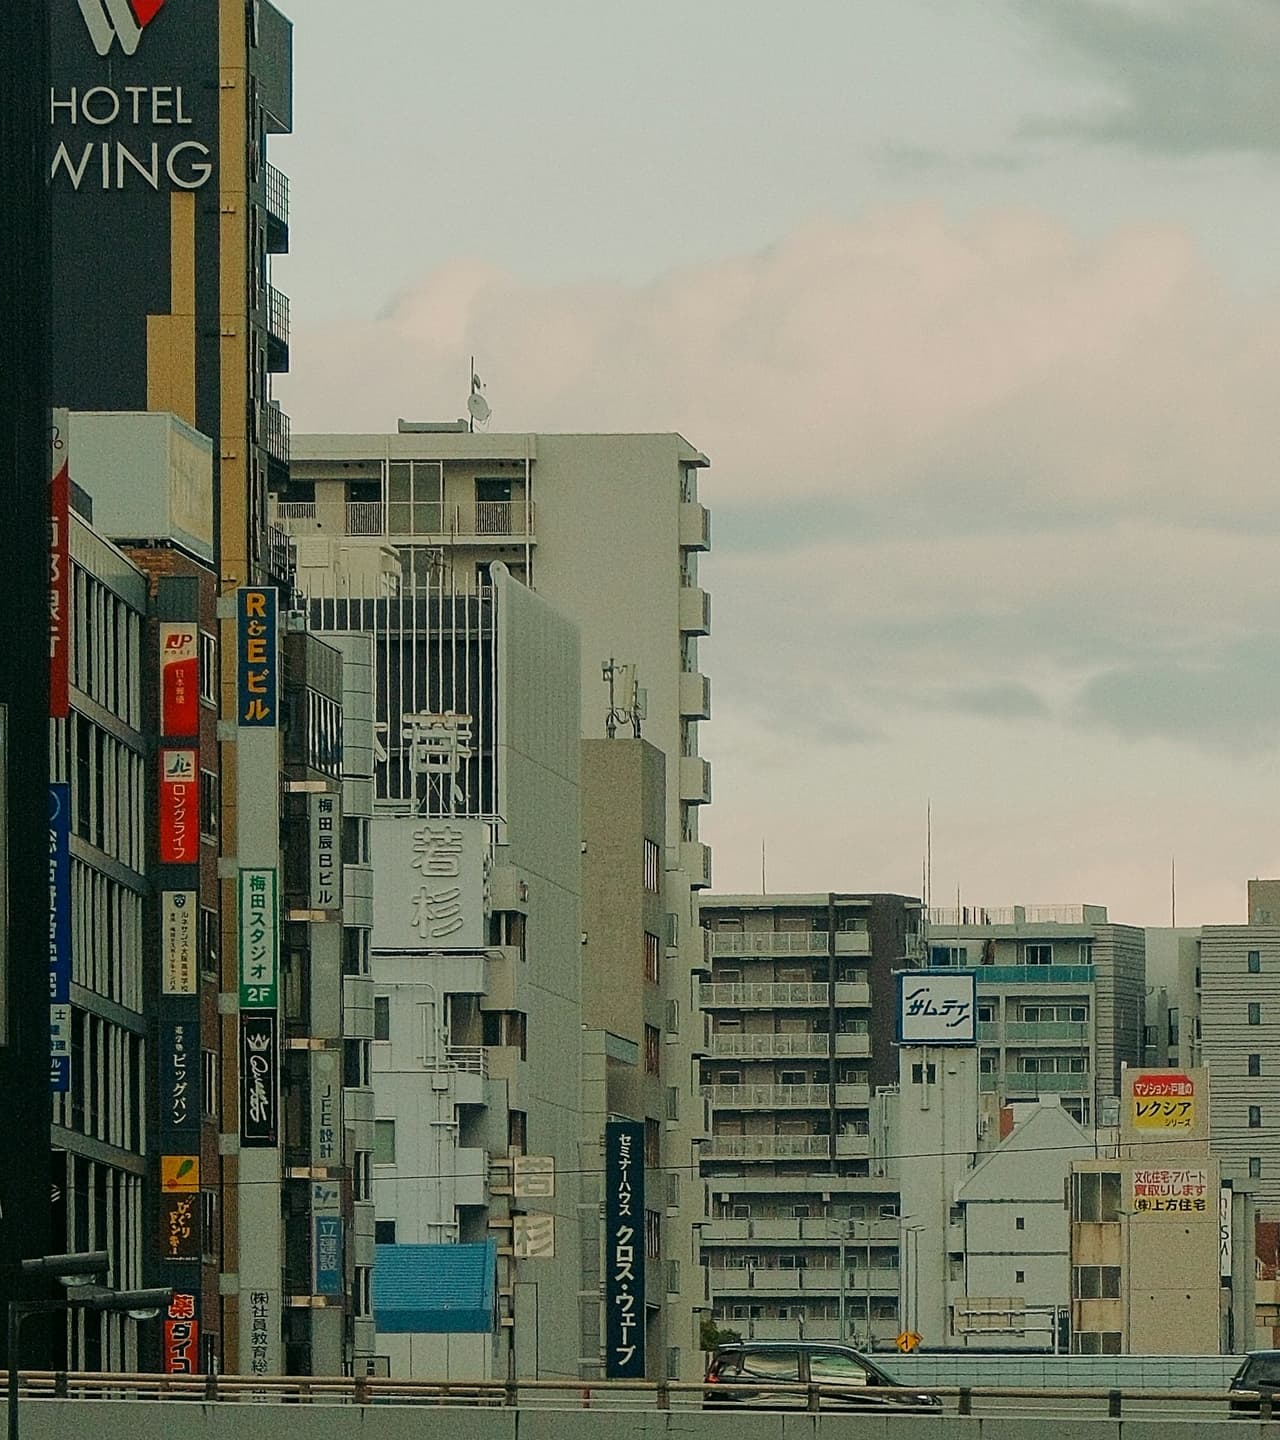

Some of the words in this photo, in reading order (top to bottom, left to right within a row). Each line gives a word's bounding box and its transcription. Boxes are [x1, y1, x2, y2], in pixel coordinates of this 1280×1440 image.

[51, 85, 192, 125] HOTEL
[245, 591, 270, 721] R&Eビル
[172, 784, 187, 860] ロングライフ
[249, 875, 266, 980] 梅田スタジオ
[247, 988, 271, 1002] 2F
[1136, 1102, 1192, 1117] レクシア
[618, 1133, 632, 1217] セミナーハウス
[1134, 1185, 1206, 1197] 買取りします
